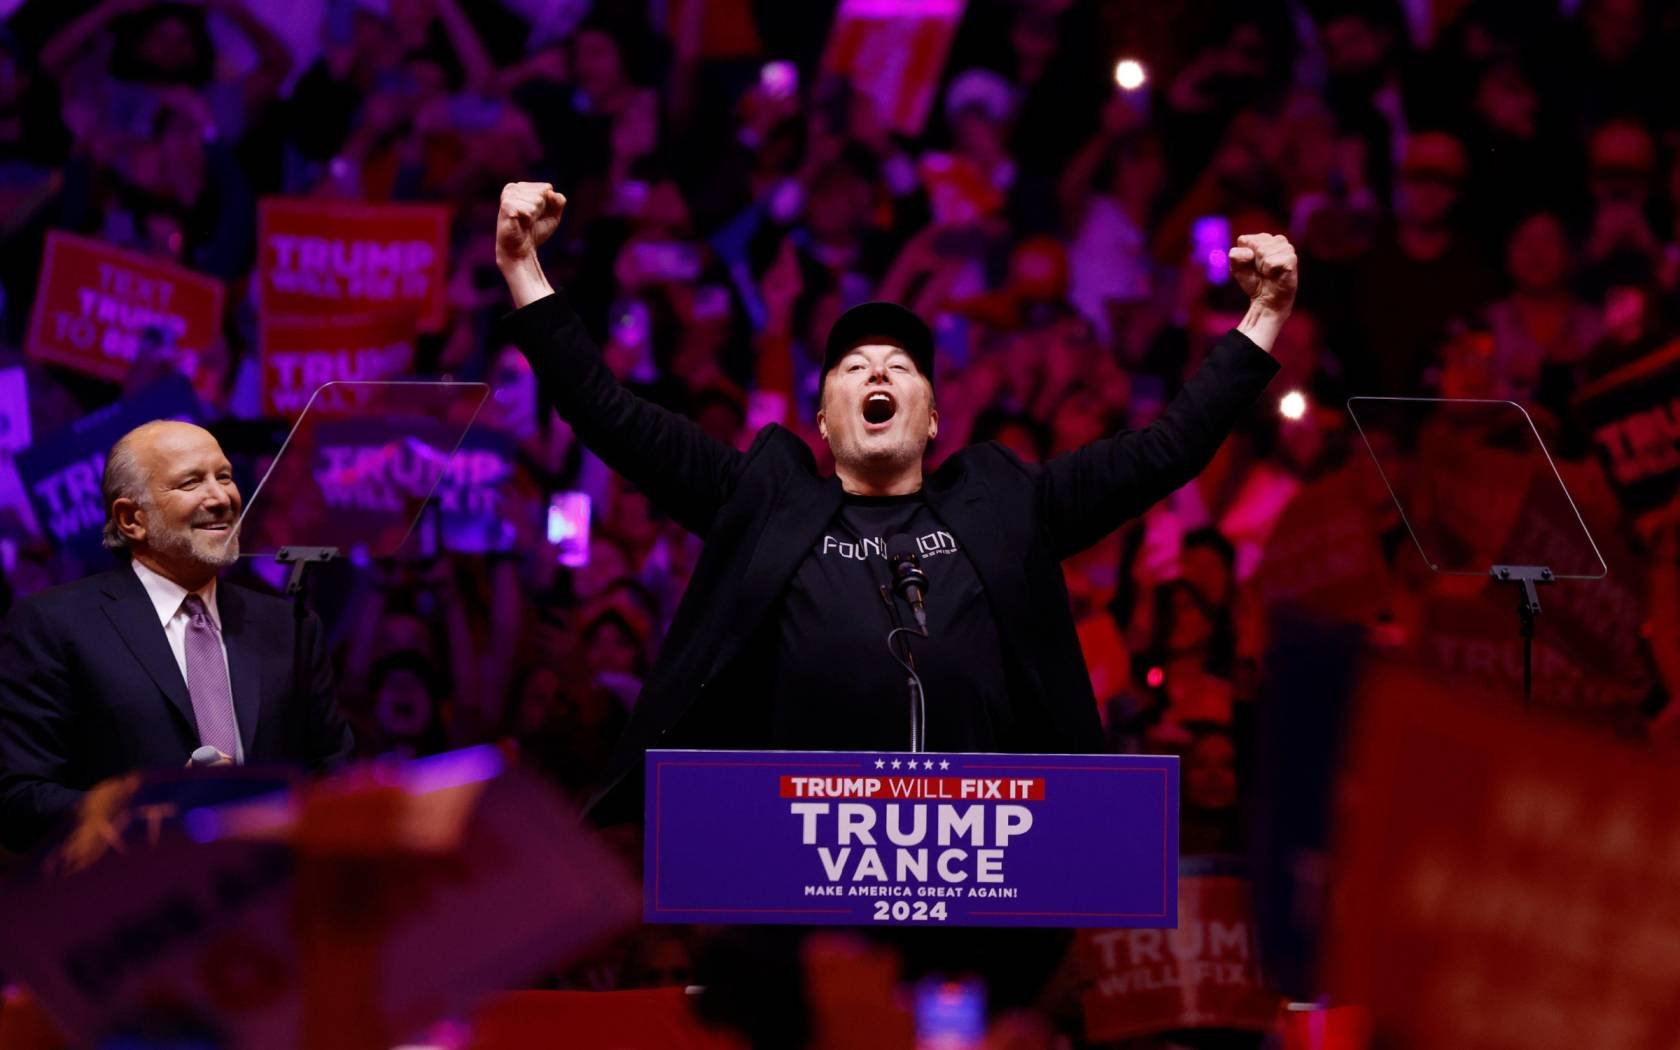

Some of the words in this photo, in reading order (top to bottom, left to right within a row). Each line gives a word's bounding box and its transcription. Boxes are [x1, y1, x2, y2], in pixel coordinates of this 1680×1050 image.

[268, 233, 435, 277] TRUMP
[97, 262, 175, 308] TEXT
[75, 285, 187, 341] TRUMP
[791, 777, 881, 797] TRUMP
[888, 778, 952, 798] WILL
[960, 779, 1001, 798] FIX
[1009, 779, 1034, 799] IT
[790, 802, 1034, 847] TRUMP
[817, 846, 1005, 883] VANCE
[804, 885, 843, 896] MAKE
[848, 886, 912, 897] AMERICA
[917, 886, 963, 897] GREAT
[968, 887, 1018, 898] AGAIN!
[873, 900, 948, 920] 2024
